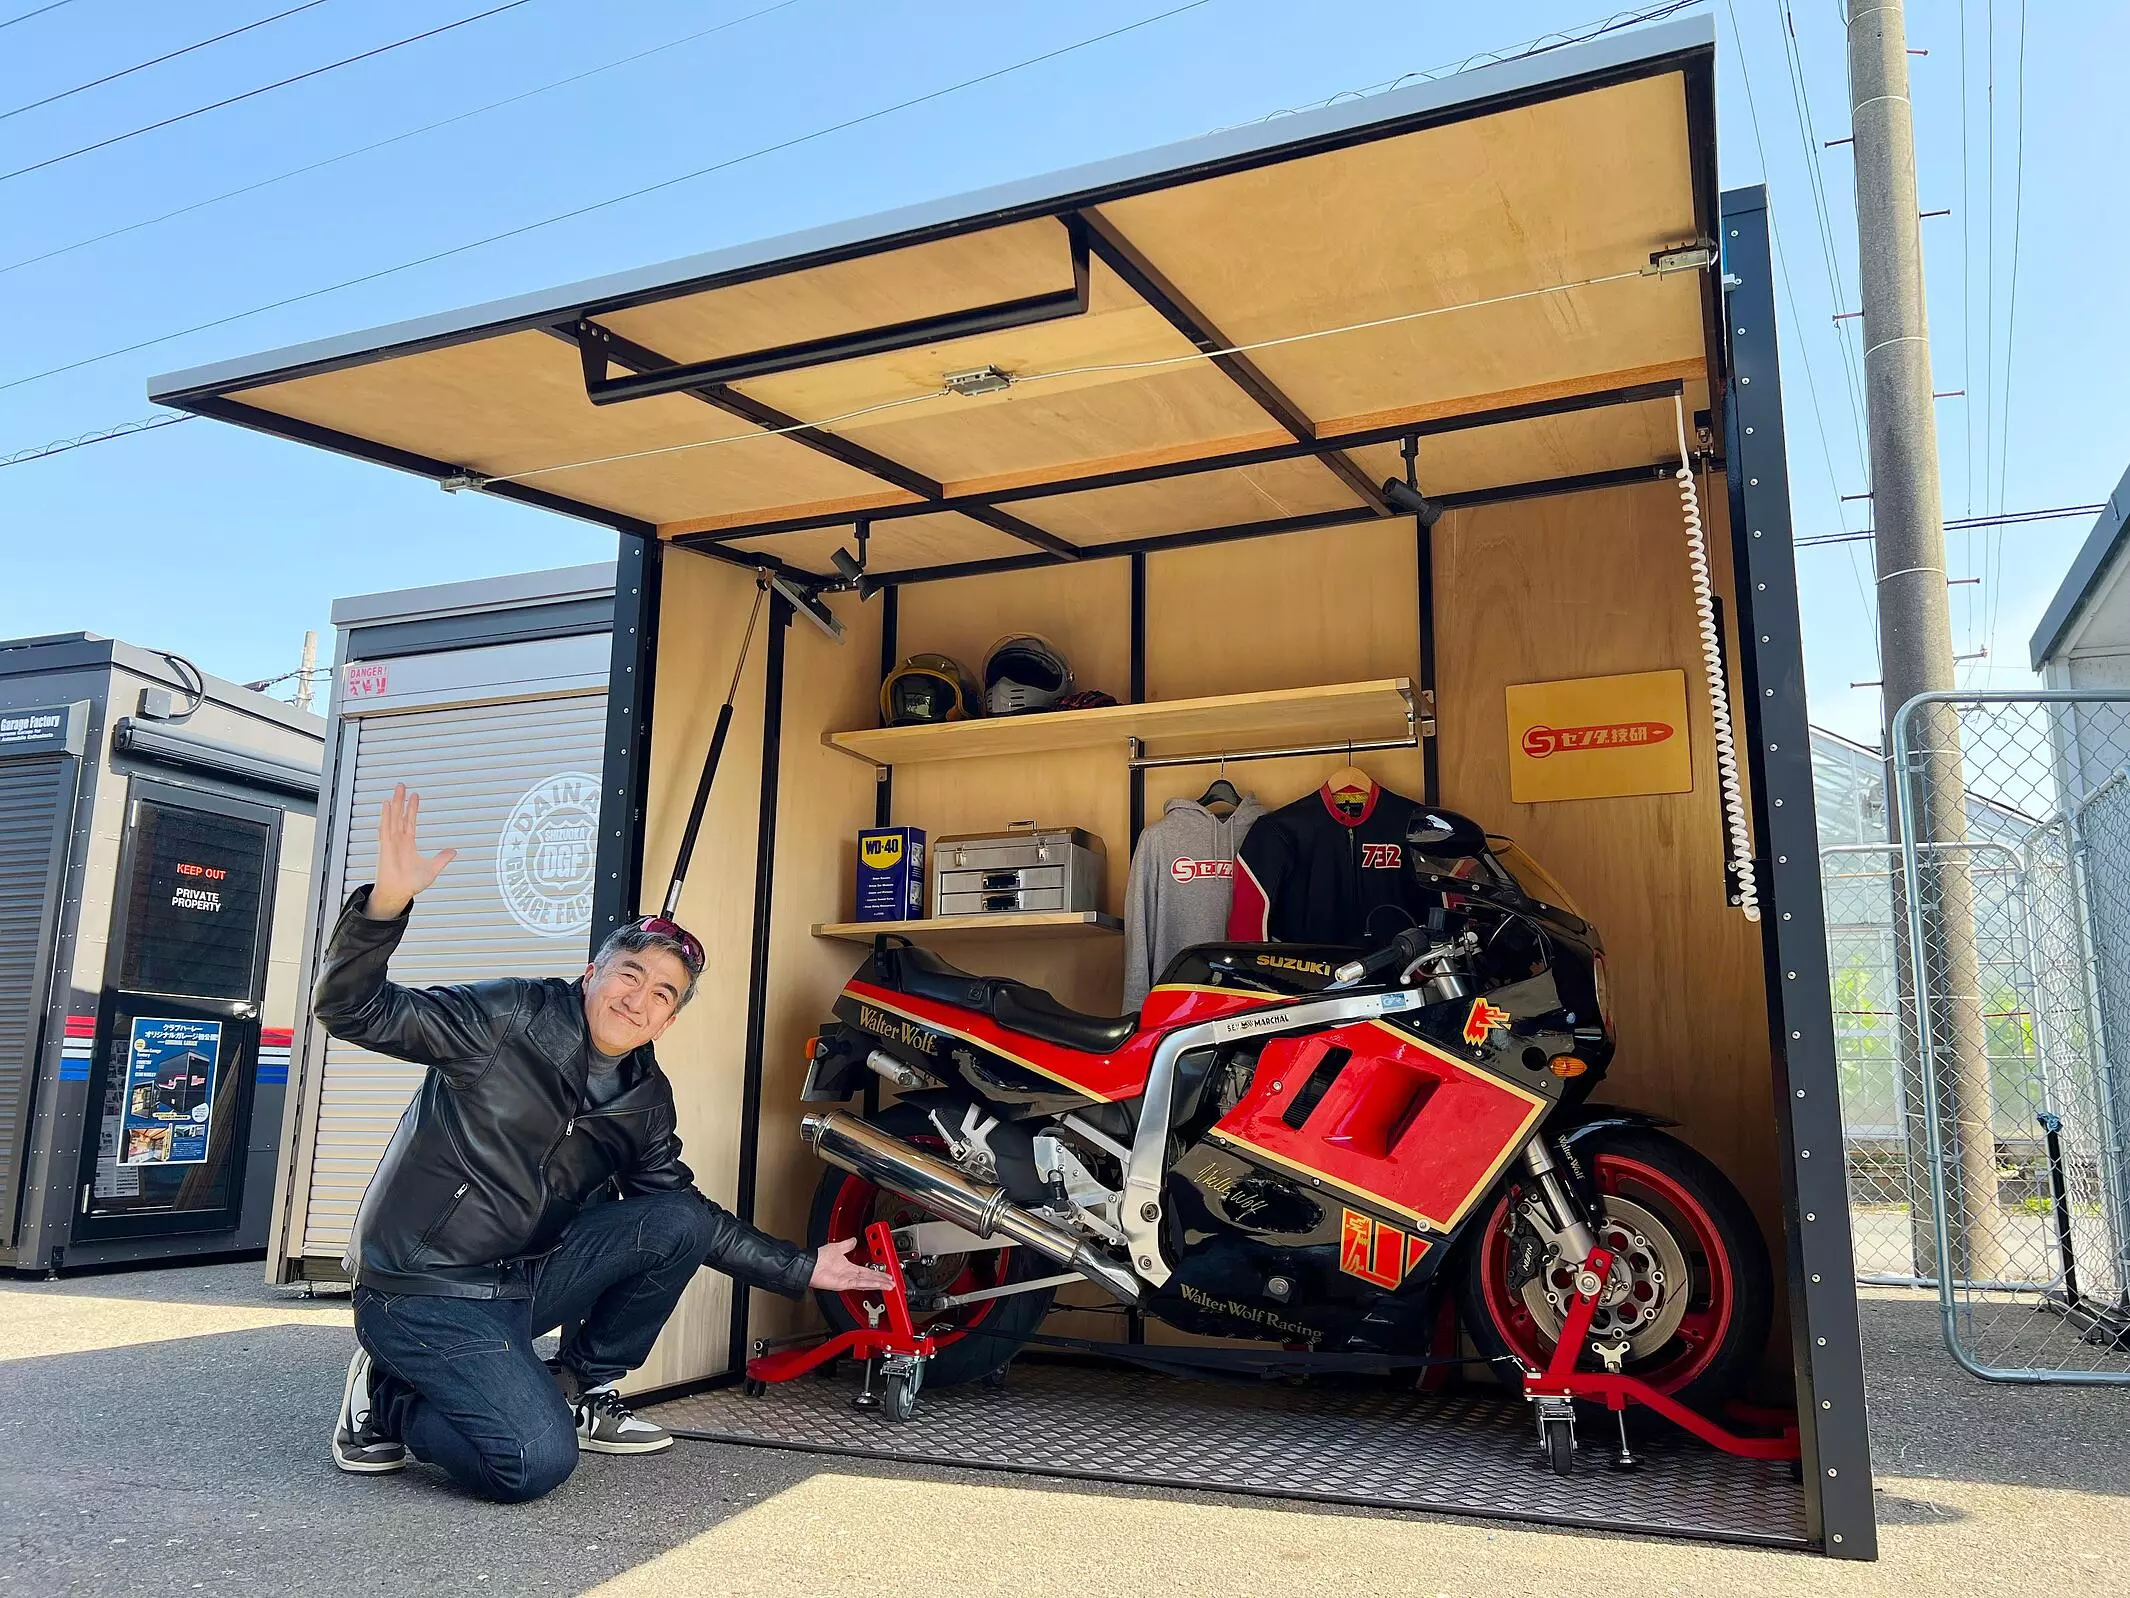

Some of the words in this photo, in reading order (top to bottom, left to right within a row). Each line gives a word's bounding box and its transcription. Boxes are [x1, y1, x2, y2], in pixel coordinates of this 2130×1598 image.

[1, 719, 29, 731] Garage
[30, 715, 60, 728] Factory
[545, 829, 586, 841] SHIZUOKA
[865, 838, 899, 855] WD-40
[1362, 844, 1401, 868] 732
[177, 863, 203, 876] KEEP
[205, 868, 227, 880] OUT
[542, 845, 586, 879] DGF
[176, 887, 220, 902] PRIVATE
[507, 857, 552, 923] GARAGE
[172, 897, 221, 912] PROPERTY
[1256, 954, 1331, 976] SUZUKI
[860, 1005, 900, 1039] Walter
[901, 1022, 938, 1053] Wolf
[1254, 1014, 1290, 1027] MARCHAL
[1558, 1134, 1574, 1160] Walter
[1570, 1159, 1586, 1179] Wolf
[1180, 1283, 1227, 1312] Walter
[1228, 1300, 1265, 1321] Wolf
[1267, 1312, 1324, 1343] Racing
